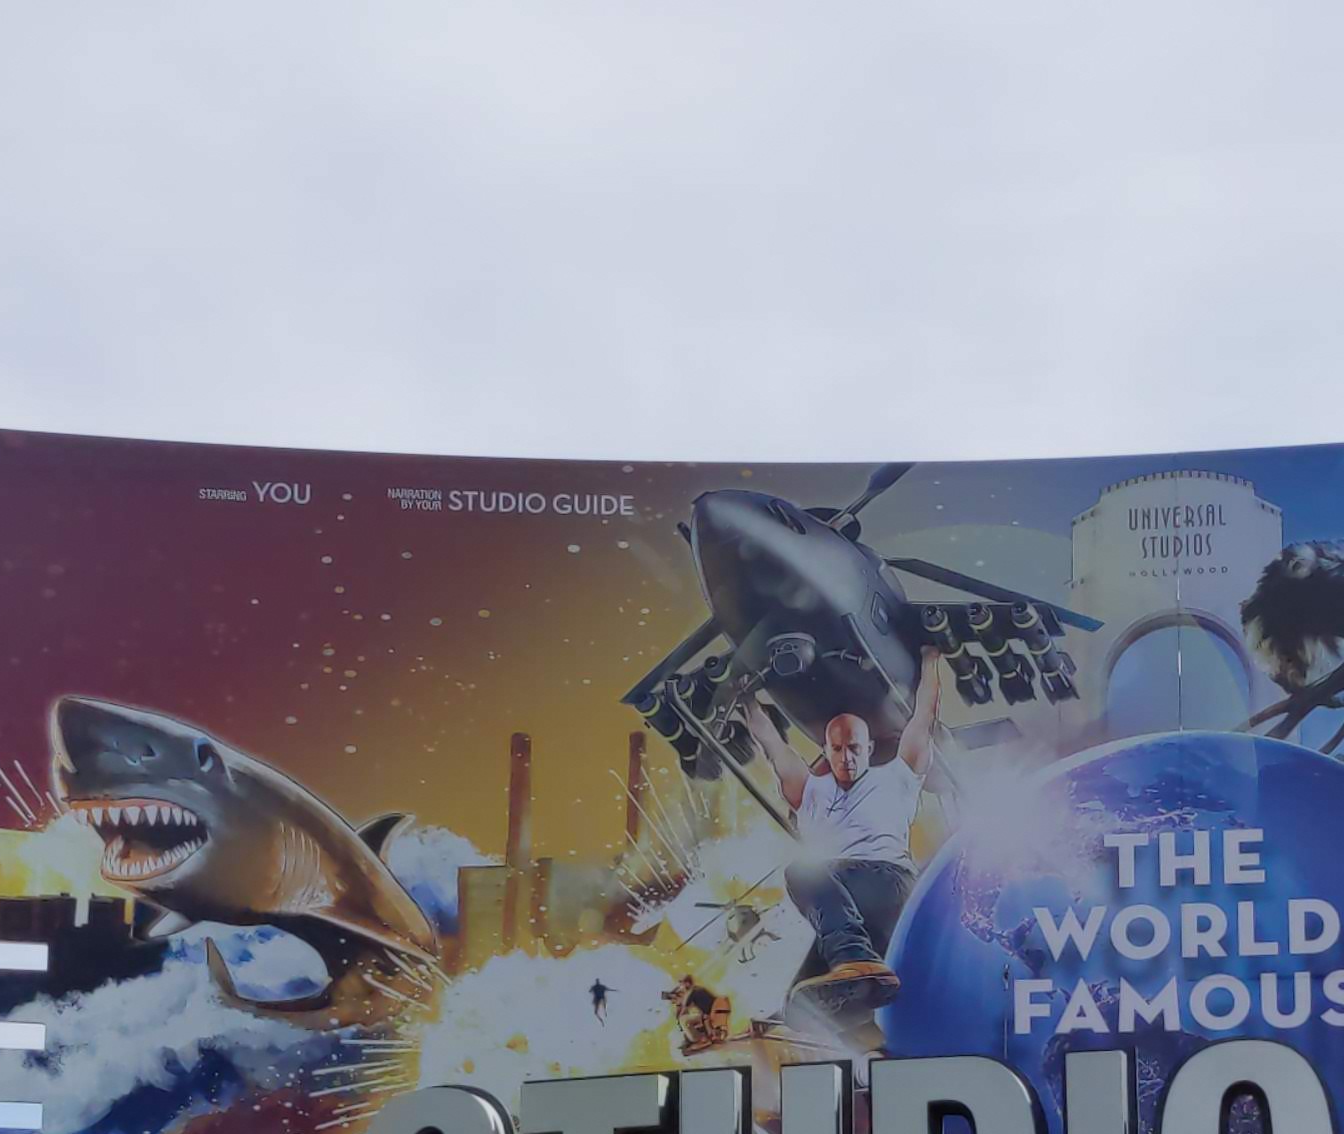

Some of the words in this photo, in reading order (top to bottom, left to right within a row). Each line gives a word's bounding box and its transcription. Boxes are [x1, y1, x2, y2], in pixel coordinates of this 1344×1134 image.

[199, 488, 247, 502] STARRING
[252, 480, 311, 505] YOU
[387, 488, 442, 501] NARRATION
[400, 499, 413, 510] BY
[415, 500, 442, 511] YOUR
[448, 490, 546, 515] STUDIO
[553, 493, 635, 517] GUIDE
[1128, 504, 1227, 531] UNIVERSAL
[1142, 533, 1212, 559] STUDIOS
[1129, 565, 1229, 578] HOLLYWOOD
[1103, 828, 1266, 888] THE
[1033, 899, 1341, 962] WORLD
